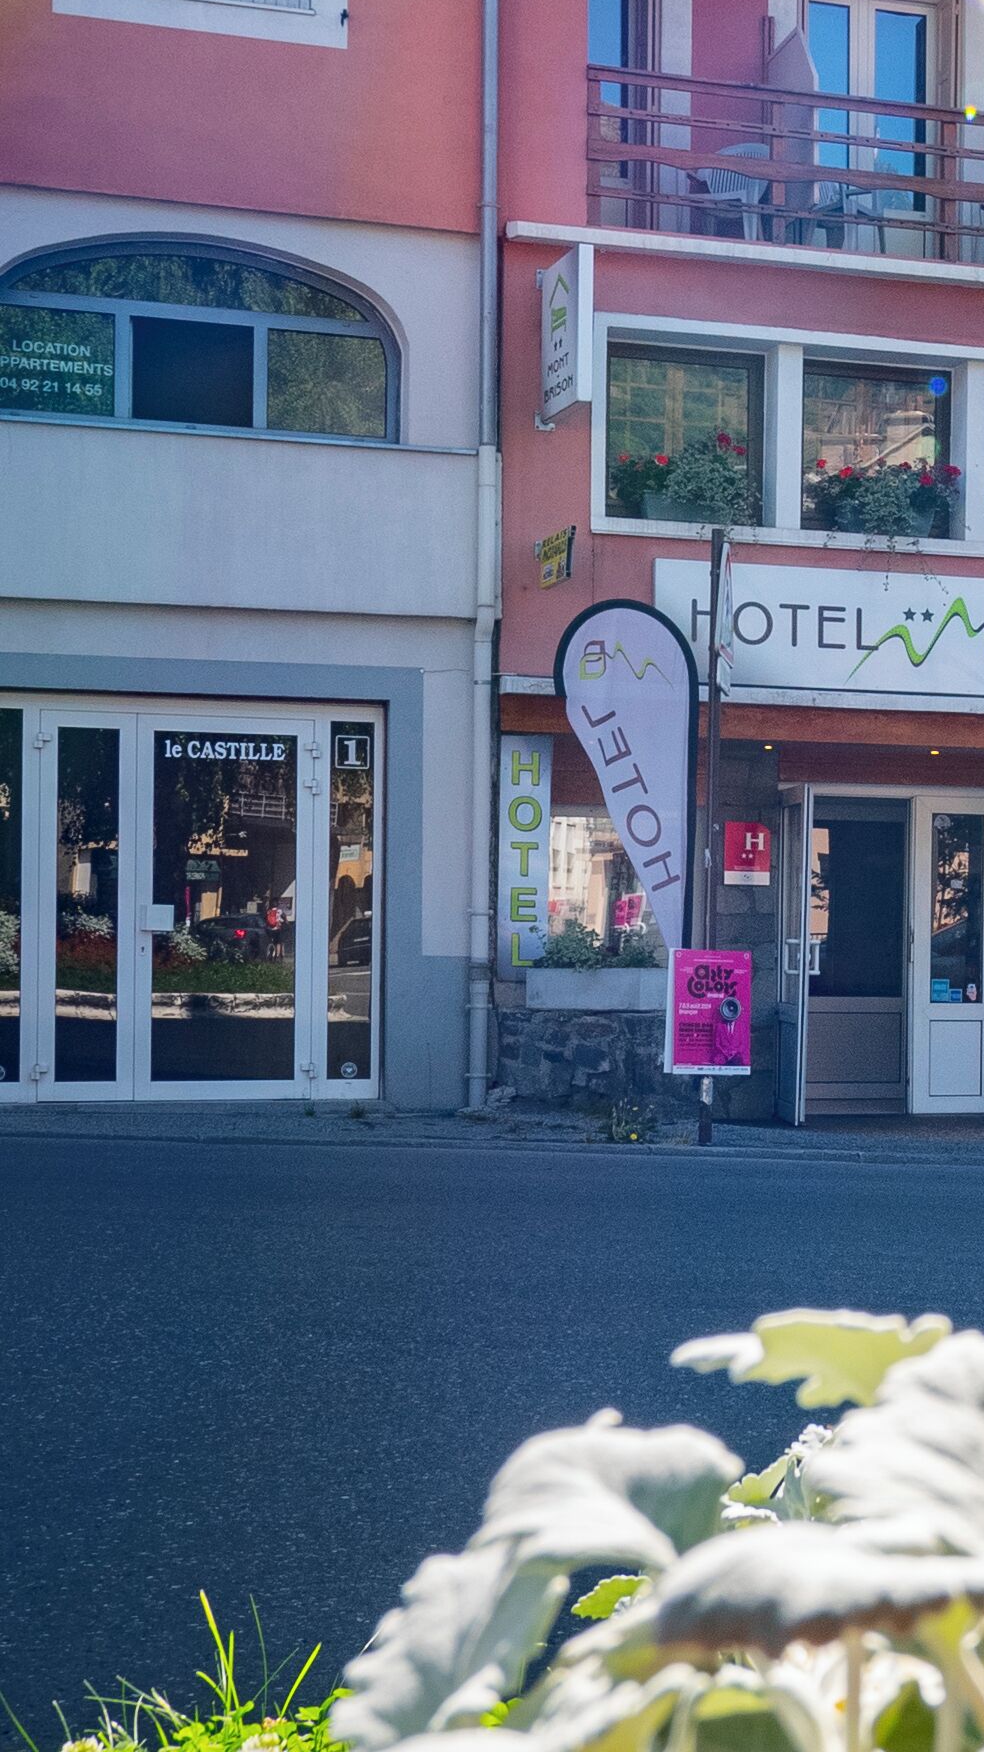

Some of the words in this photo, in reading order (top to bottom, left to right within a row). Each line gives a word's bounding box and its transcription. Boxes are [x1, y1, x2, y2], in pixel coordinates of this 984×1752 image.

[12, 340, 91, 357] LOCATION
[0, 356, 114, 377] PPARTEMENTS
[547, 351, 570, 377] MONT
[0, 377, 17, 388] 04
[21, 379, 39, 391] 92
[42, 380, 59, 393] 21
[65, 382, 81, 394] 14
[84, 384, 103, 396] 55
[544, 374, 574, 404] BRISON
[691, 598, 880, 652] HOTEL
[164, 739, 183, 758] le
[187, 740, 286, 761] CASTILLE
[343, 739, 362, 765] 1
[745, 832, 765, 851] H
[508, 750, 543, 967] HOTEL
